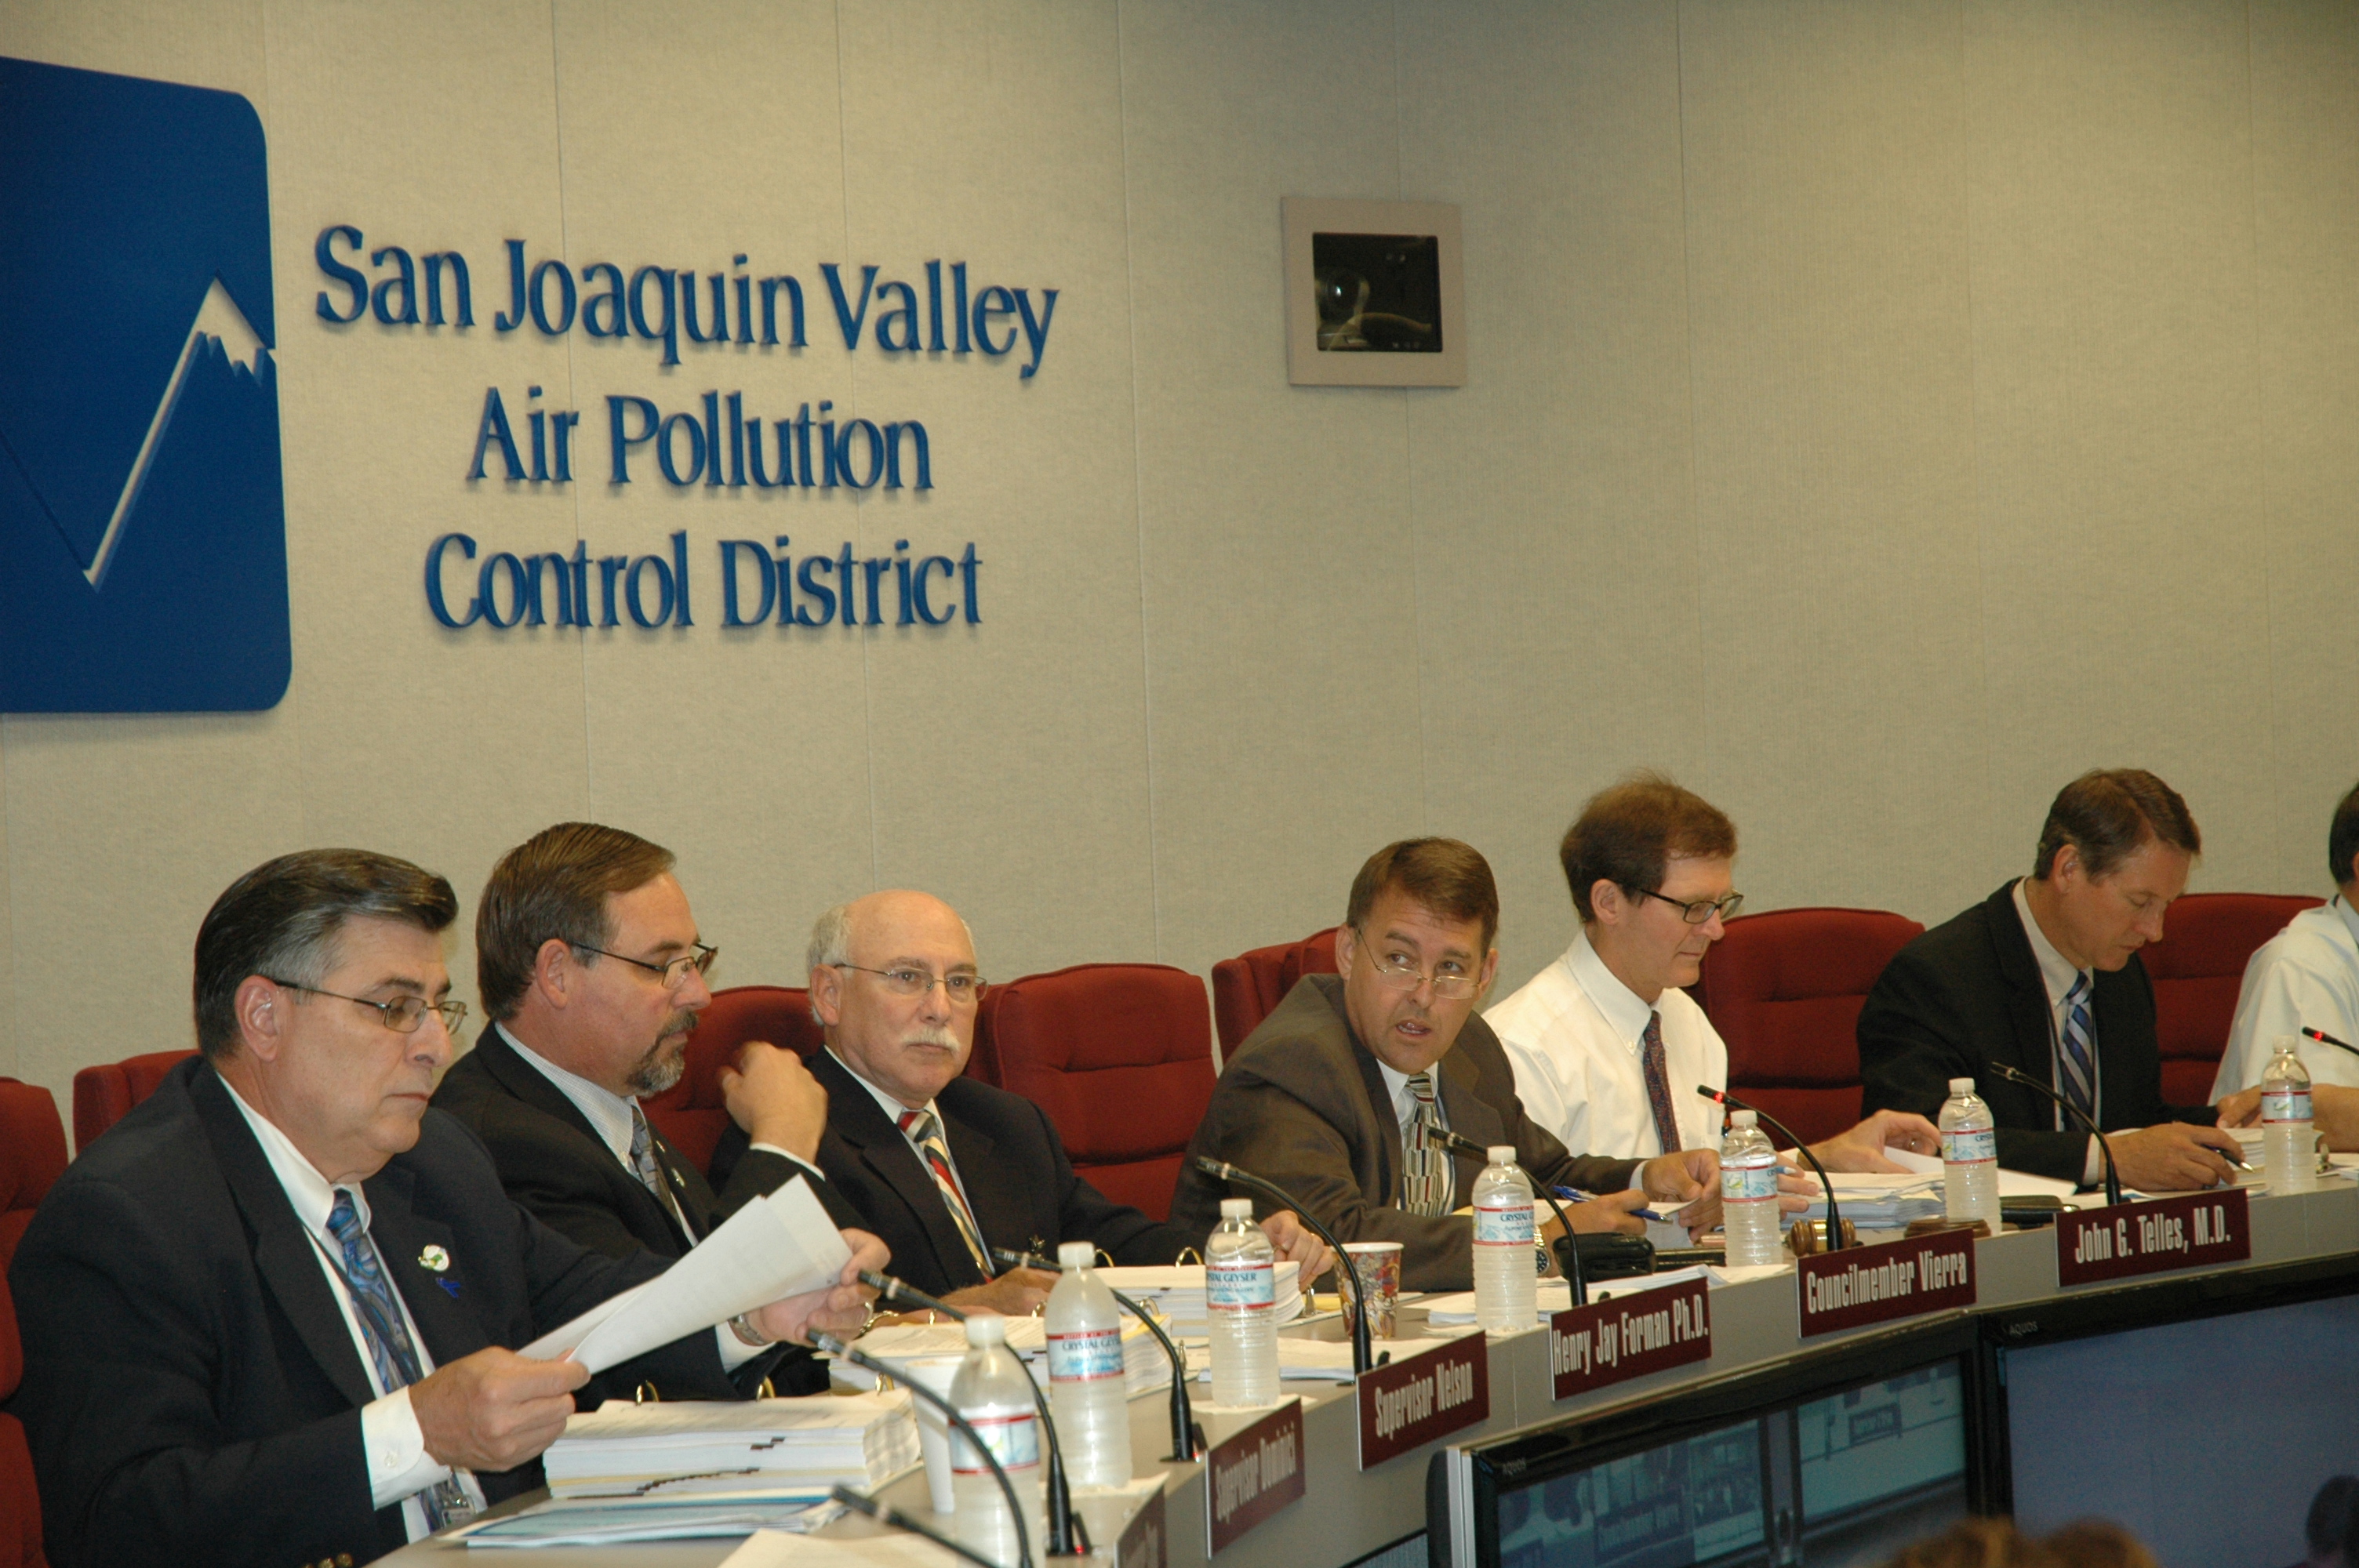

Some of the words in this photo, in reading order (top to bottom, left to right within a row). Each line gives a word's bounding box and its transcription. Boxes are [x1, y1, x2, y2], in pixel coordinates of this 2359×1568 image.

[314, 223, 475, 330] San
[495, 238, 809, 367] Joaquin
[819, 258, 1060, 379] Valley
[466, 385, 579, 483] Air
[605, 389, 935, 489] Pollution
[424, 530, 695, 628] Control
[718, 534, 983, 626] District
[2075, 1222, 2112, 1264] John
[2117, 1218, 2133, 1257] G.
[2137, 1213, 2189, 1254] Telles,
[2194, 1205, 2231, 1246] M.D.
[1807, 1257, 1915, 1314] Councilmember
[1918, 1250, 1967, 1292] Vierra
[1553, 1327, 1590, 1375] Henry
[1595, 1318, 1618, 1367] Jay
[1621, 1310, 1671, 1357] Forman
[1673, 1294, 1709, 1343] Ph.D.
[2009, 1320, 2038, 1336] AQUOS
[1375, 1375, 1435, 1440] Supervisor
[1436, 1360, 1474, 1412] Nelson
